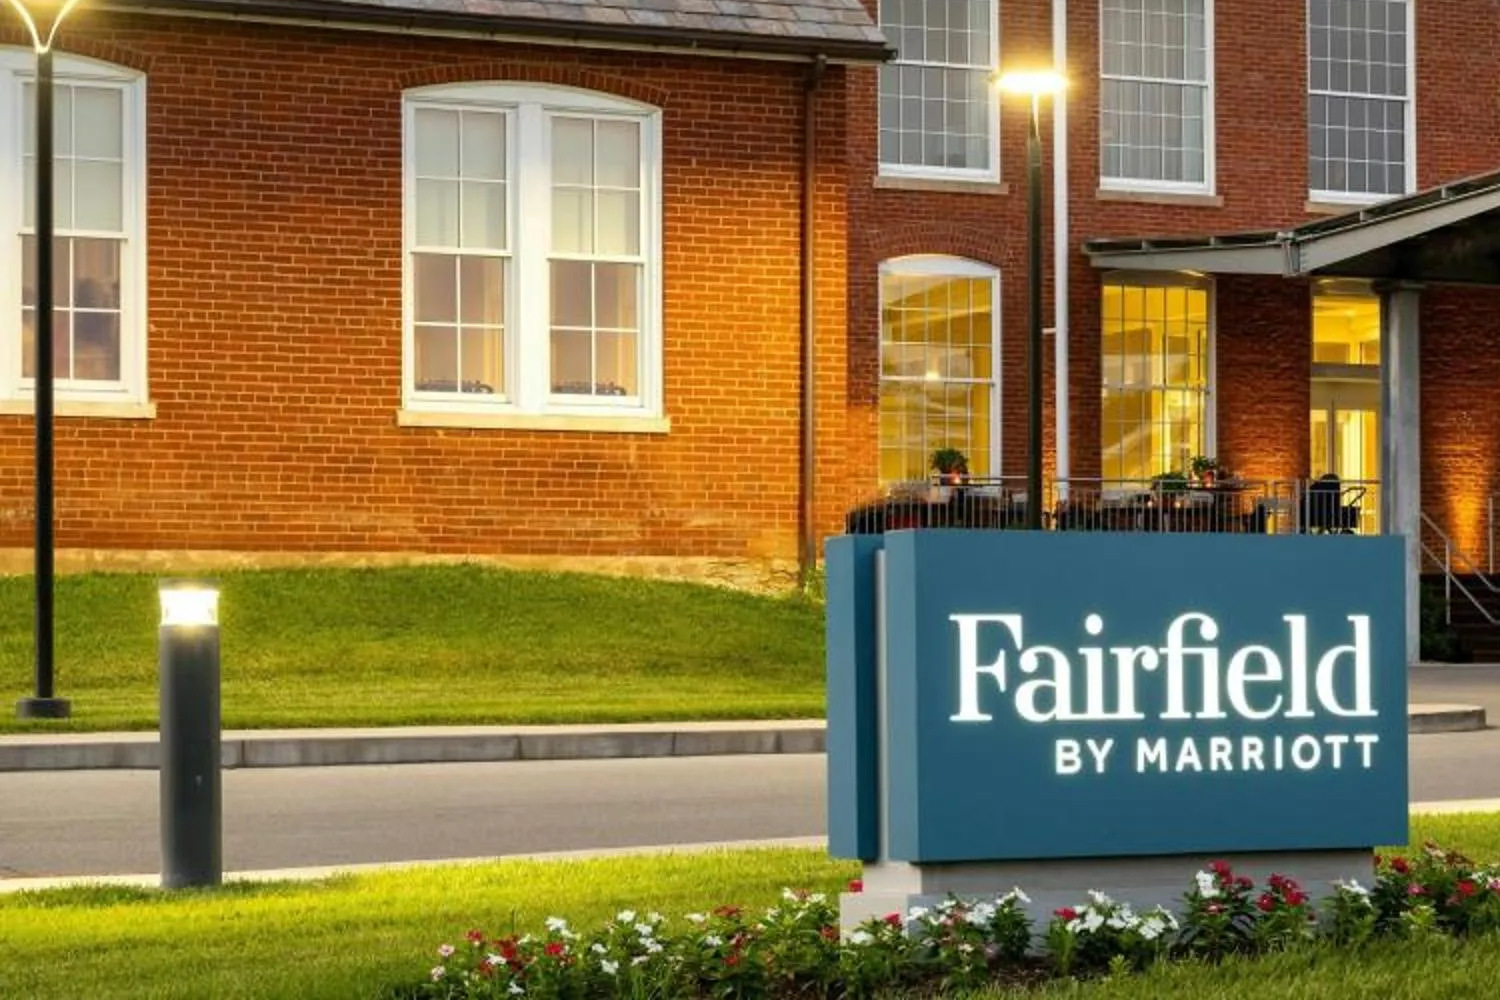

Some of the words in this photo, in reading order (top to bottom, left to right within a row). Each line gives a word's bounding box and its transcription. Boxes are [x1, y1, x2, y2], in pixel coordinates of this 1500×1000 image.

[948, 611, 1379, 723] Fairfield
[1054, 738, 1114, 775] BY
[1136, 734, 1380, 773] MARRIOTT
